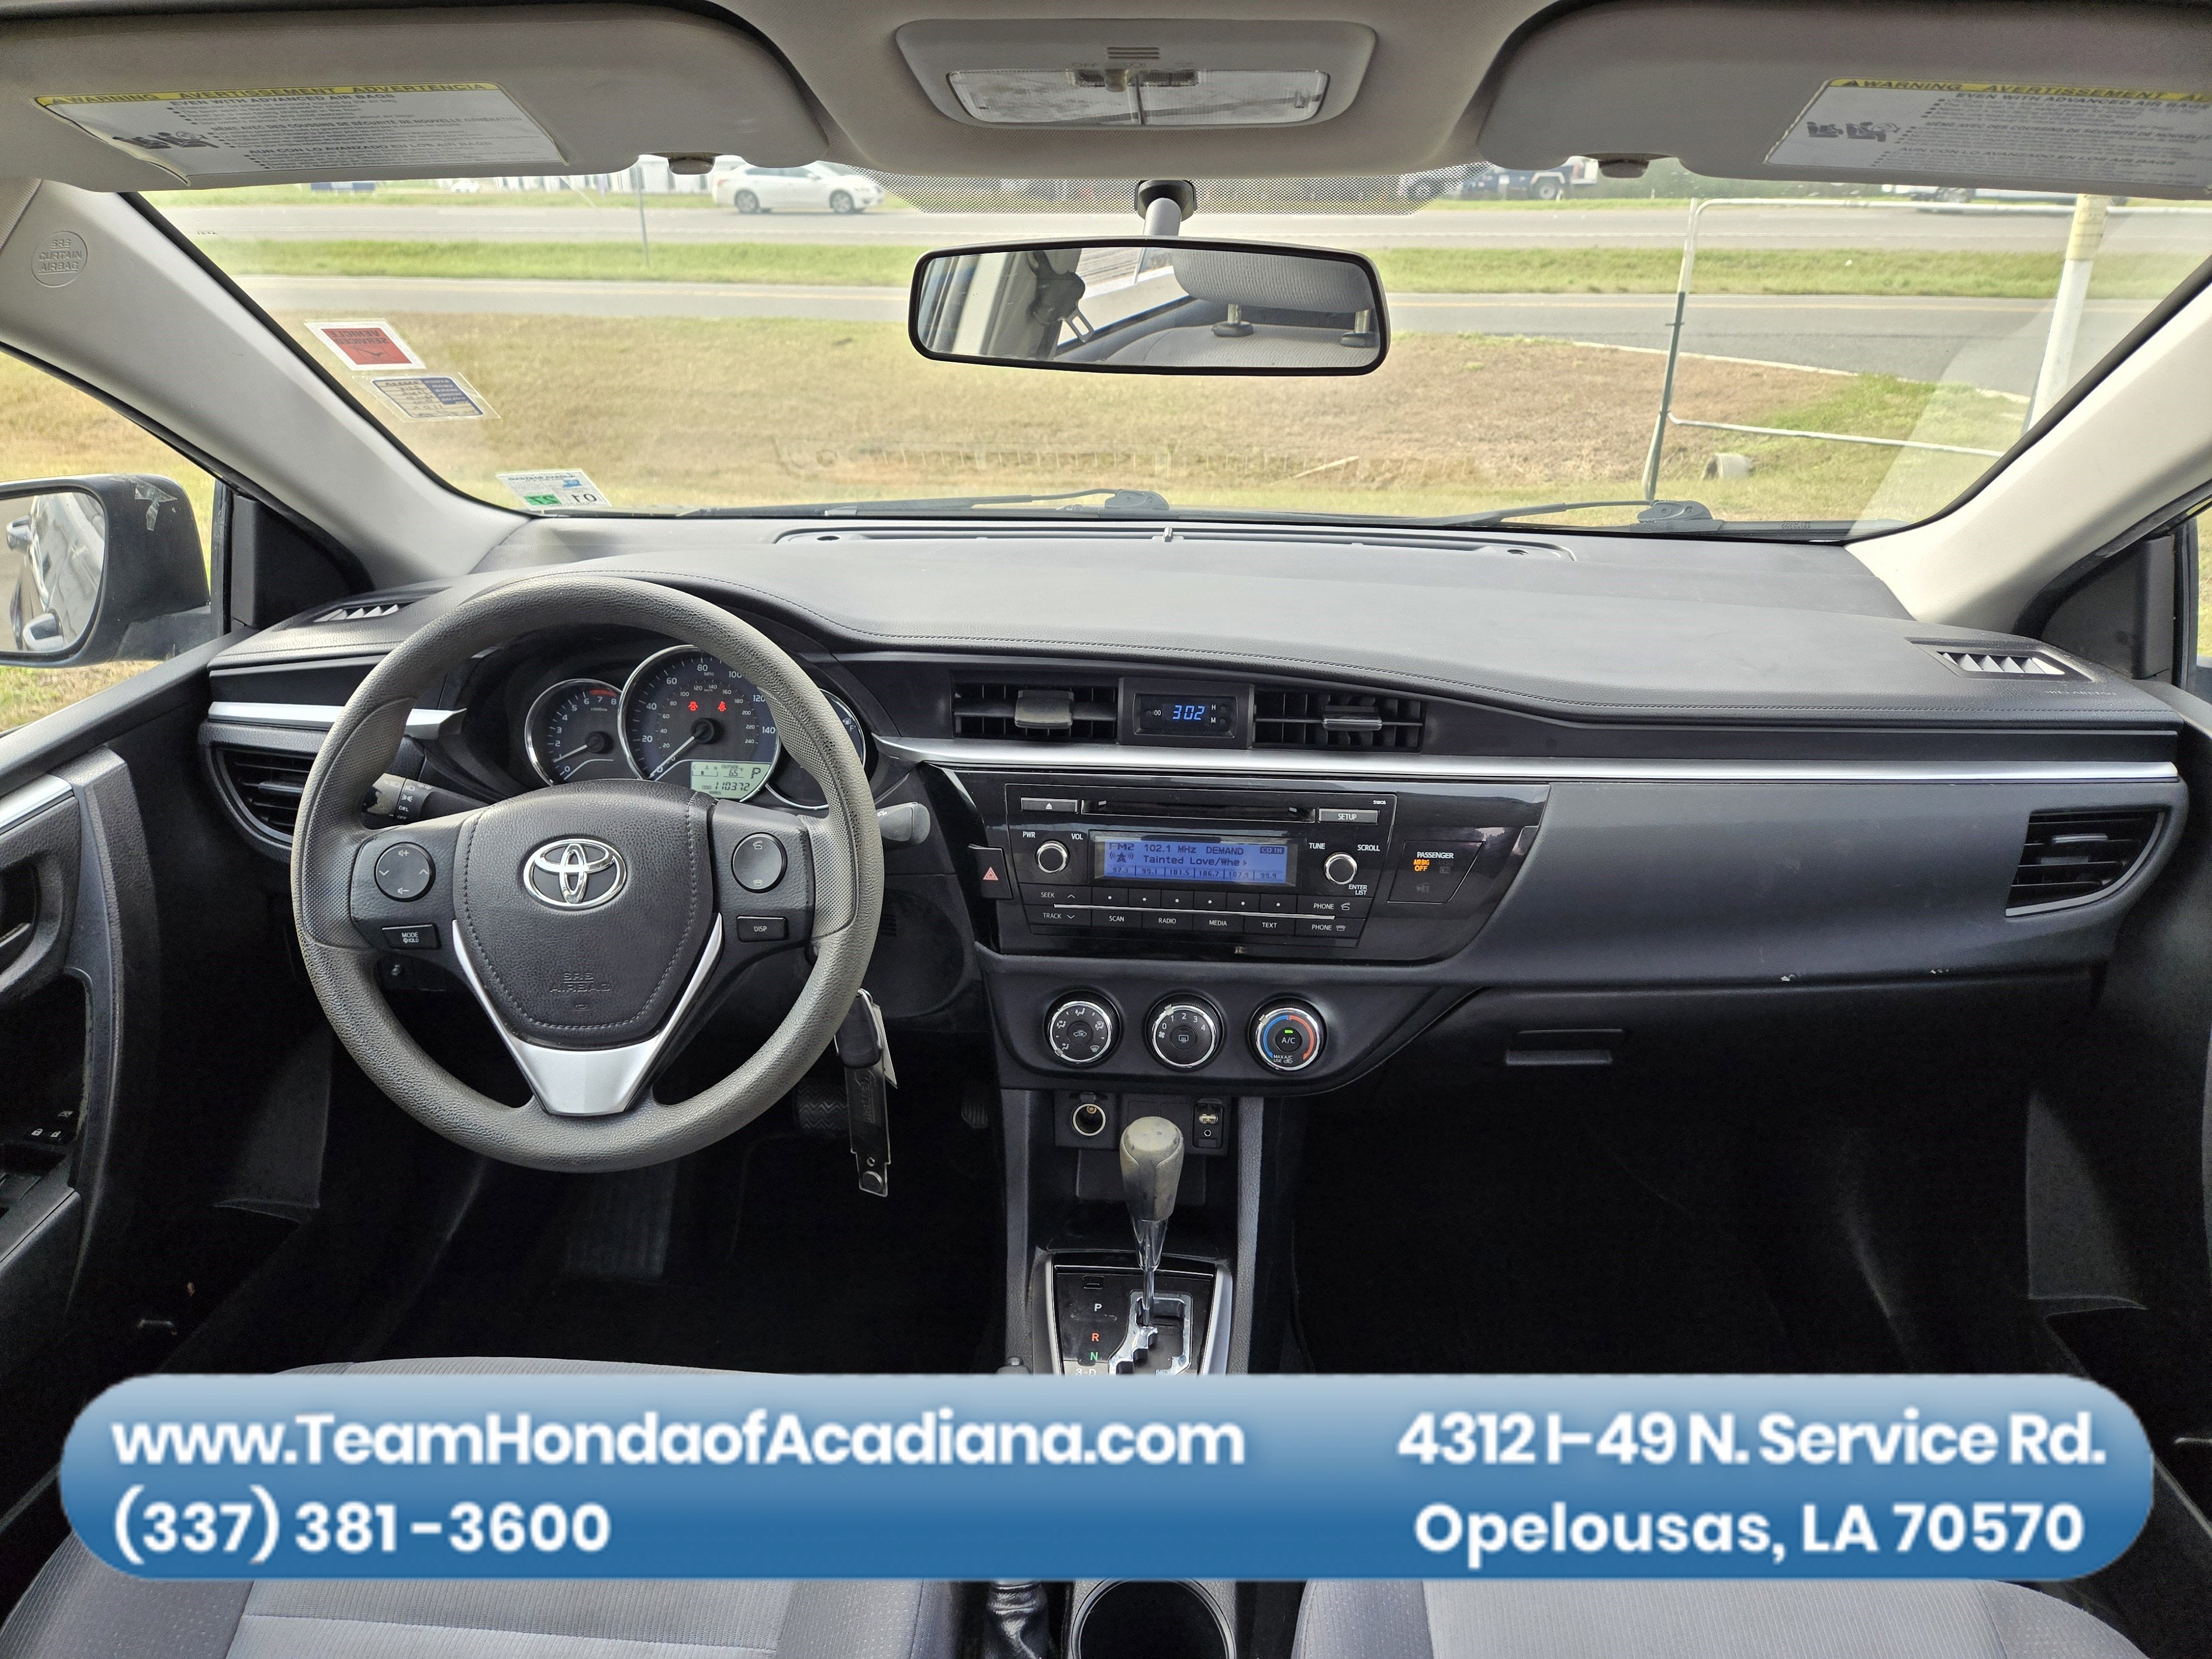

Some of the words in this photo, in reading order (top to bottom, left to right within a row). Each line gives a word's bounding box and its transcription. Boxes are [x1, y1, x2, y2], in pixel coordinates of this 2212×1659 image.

[64, 93, 159, 103] WARNING
[179, 88, 335, 99] AVERTISSEMENT
[353, 83, 487, 93] ADVERTENCIA
[50, 238, 72, 248] SRS
[39, 250, 82, 262] CURTAIN
[38, 261, 79, 272] AIRBAG
[750, 767, 761, 779] P
[715, 781, 750, 791] 110372
[1109, 842, 1135, 851] FM2
[1144, 844, 1171, 853] 102.1
[1206, 847, 1244, 855] DEMAND
[1143, 855, 1184, 864] Tainted
[1190, 857, 1240, 867] Love/Whe
[564, 972, 594, 981] SRS
[549, 984, 610, 993] AIRBAG
[1094, 1303, 1103, 1312] P
[1092, 1333, 1099, 1342] R
[1090, 1352, 1098, 1361] N
